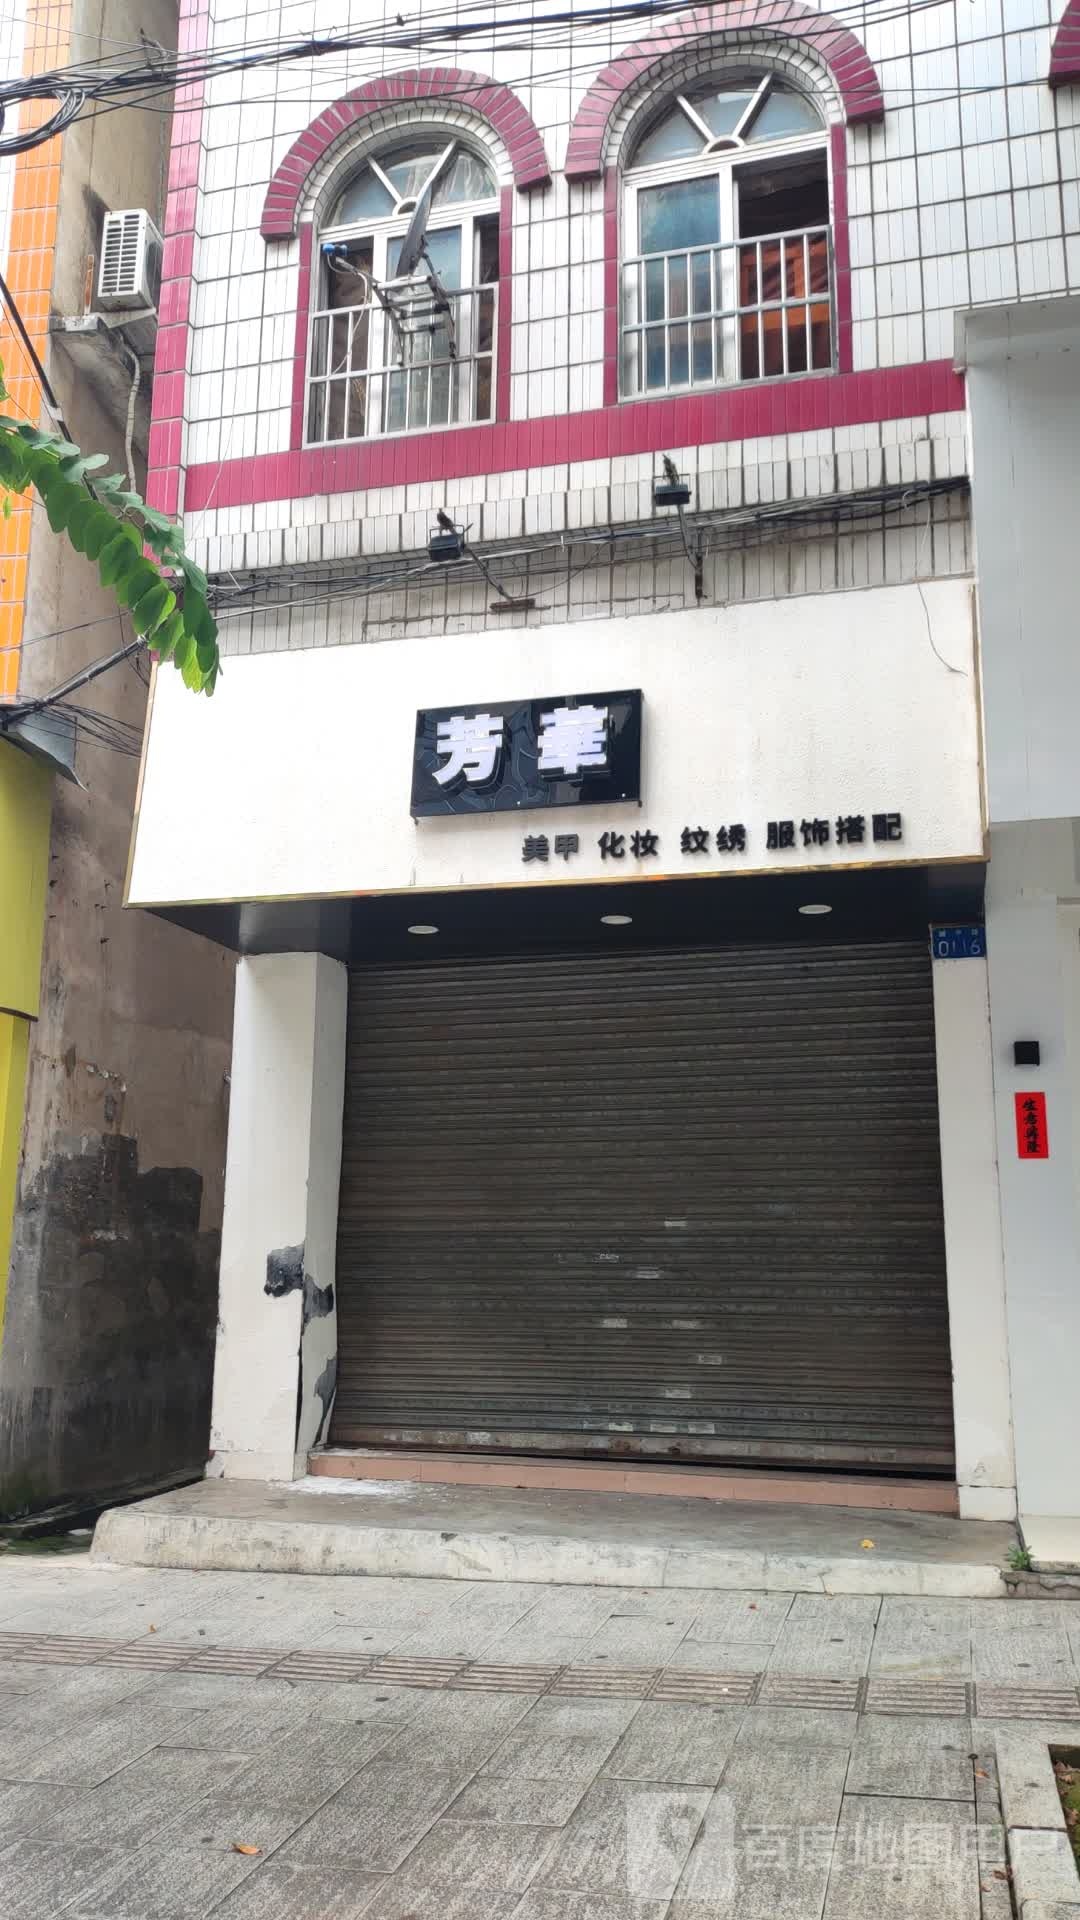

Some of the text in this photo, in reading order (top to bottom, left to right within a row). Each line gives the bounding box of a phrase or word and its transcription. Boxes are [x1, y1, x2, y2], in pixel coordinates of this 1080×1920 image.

[432, 704, 609, 788] 芳華
[522, 812, 902, 862] 美甲 化妆 纹绣 服饰搭配
